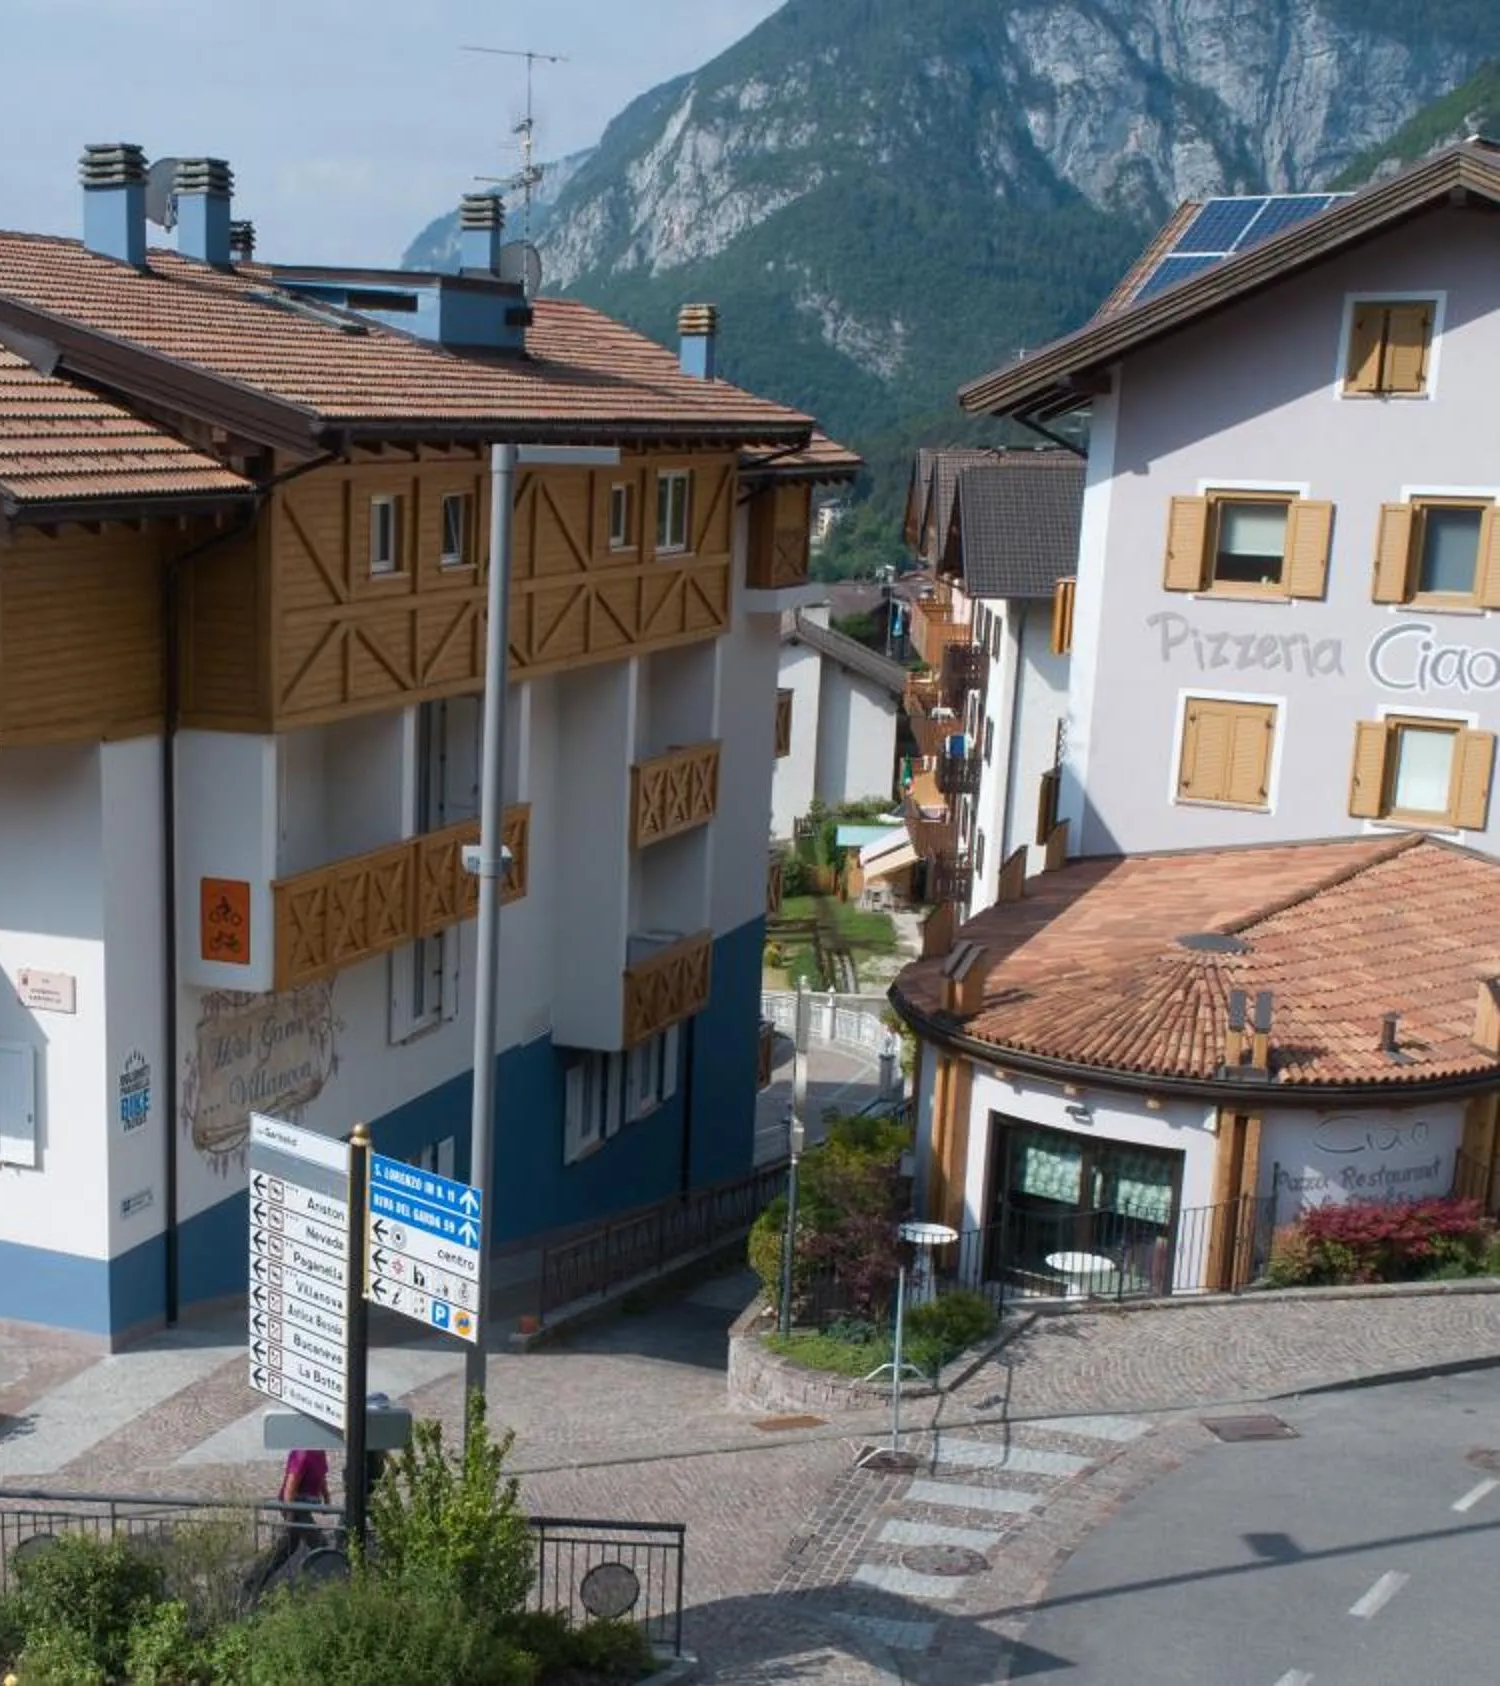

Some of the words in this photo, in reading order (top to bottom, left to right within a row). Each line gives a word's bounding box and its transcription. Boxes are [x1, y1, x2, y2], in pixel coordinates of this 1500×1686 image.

[1146, 611, 1345, 677] Pizzeria
[1368, 622, 1500, 691] Ciao
[1313, 1115, 1429, 1154] Ciao
[383, 1166, 422, 1190] LORENZO
[1341, 1157, 1442, 1190] Restaurant
[307, 1197, 346, 1223] Ariston
[305, 1225, 345, 1251] Nevada
[292, 1246, 344, 1282] Paganella
[295, 1280, 344, 1311] Villanova
[292, 1332, 344, 1366] Bucaneve
[297, 1363, 311, 1379] La
[313, 1371, 344, 1394] Botte
